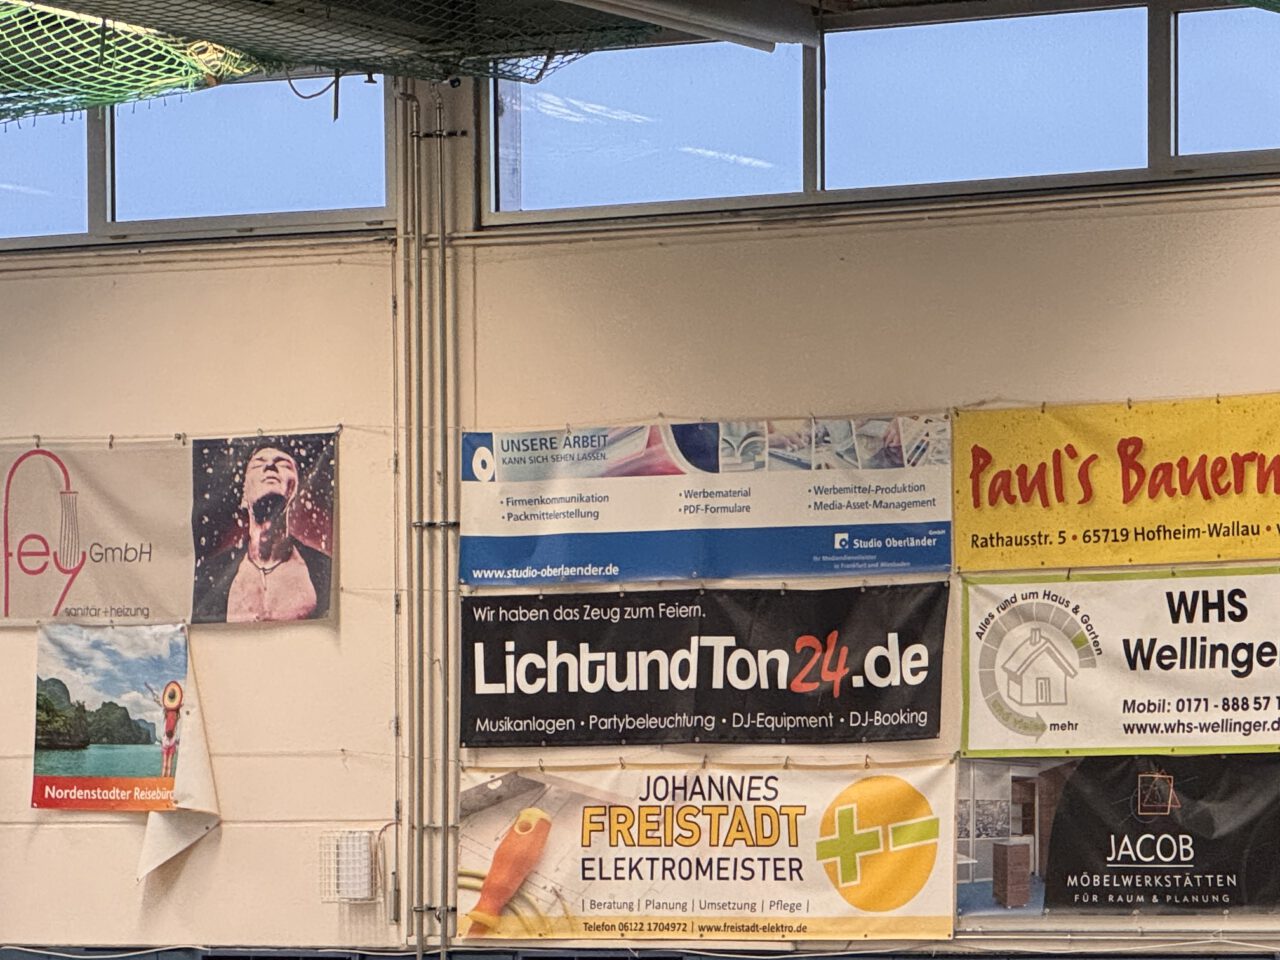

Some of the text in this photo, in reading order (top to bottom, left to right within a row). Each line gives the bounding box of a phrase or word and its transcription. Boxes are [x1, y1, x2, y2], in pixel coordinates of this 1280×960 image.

[500, 433, 608, 453] UNSERE ARBEIT
[502, 452, 608, 465] KANN SICH SEHEN LASSEN.
[970, 446, 1099, 509] Paul's
[683, 487, 751, 499] Werbematerial
[813, 481, 926, 496] Werbemittel-Produktion
[505, 492, 609, 507] Firmenkommunikation
[813, 498, 936, 511] Media-Asset-Management
[507, 509, 599, 522] Packmittelerstellung
[683, 503, 751, 514] PDF-Formulare
[853, 536, 937, 549] Studio Oberländer
[971, 529, 1053, 549] Rathausstr.
[1057, 530, 1067, 545] 5
[1082, 527, 1130, 544] 65719
[1134, 521, 1260, 542] Hofheim-Wallau
[89, 542, 152, 563] GmbH
[472, 563, 620, 579] www.studio-oberlaender.de
[473, 602, 706, 624] Wir haben das Zeug zum Feiern.
[1166, 588, 1248, 625] WHS
[975, 590, 1103, 656] Alles rund um Haus & Garten
[474, 630, 929, 698] LichtundTon24.de
[1122, 696, 1171, 714] Mobil:
[1176, 695, 1209, 713] 0171
[1222, 695, 1252, 711] 888
[1254, 695, 1273, 711] 57
[475, 709, 928, 732] Musikanlagen Partybeleuchtung DJ-Equipment DJ-Booking
[1050, 721, 1079, 731] mehr
[45, 785, 131, 800] Nordenstadter
[638, 775, 779, 802] JOHANNES
[581, 805, 807, 848] FREISTADT
[1107, 833, 1194, 863] JACOB
[581, 857, 804, 882] ELEKTROMEISTER
[1066, 871, 1237, 888] MÖBELWERKSTÄTTEN
[589, 898, 802, 913] Beratung Planung Umsetzung Pflege
[1074, 892, 1230, 903] FÜR RAUM & PLANUNG
[583, 921, 807, 934] Telefon 06122 1704972 www.freistadt-elektro.de
